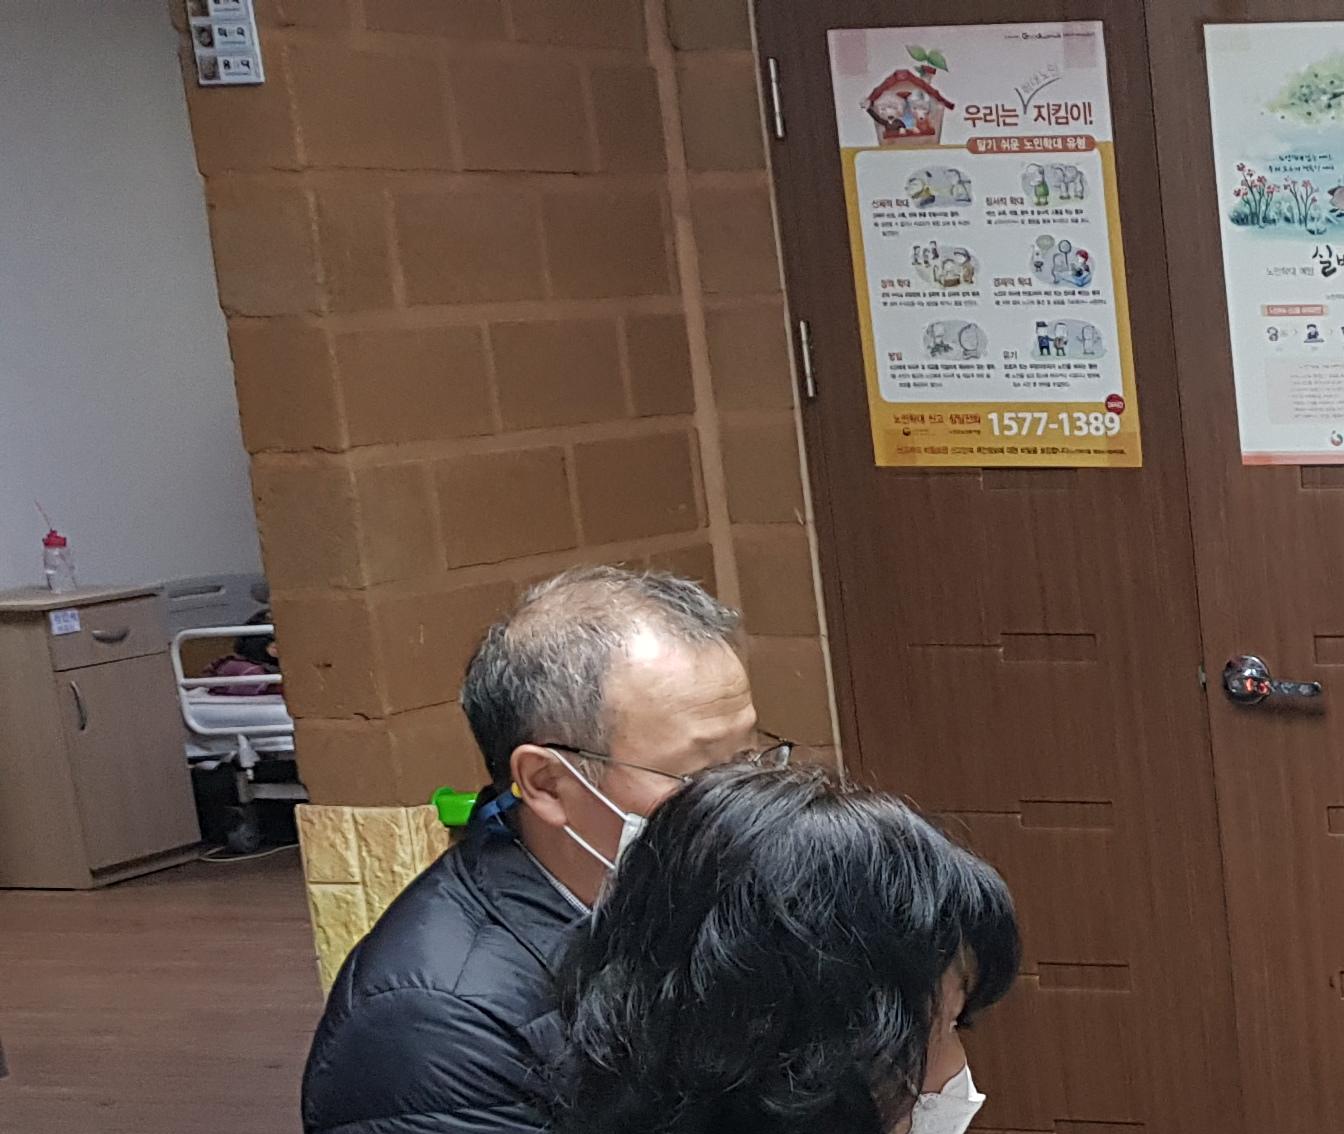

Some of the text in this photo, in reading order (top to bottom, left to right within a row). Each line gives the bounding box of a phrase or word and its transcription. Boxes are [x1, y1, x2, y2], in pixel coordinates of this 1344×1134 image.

[964, 102, 1093, 127] 우리는 지킴이!
[1024, 137, 1062, 150] 노인학대
[988, 412, 1121, 437] 1577-1389
